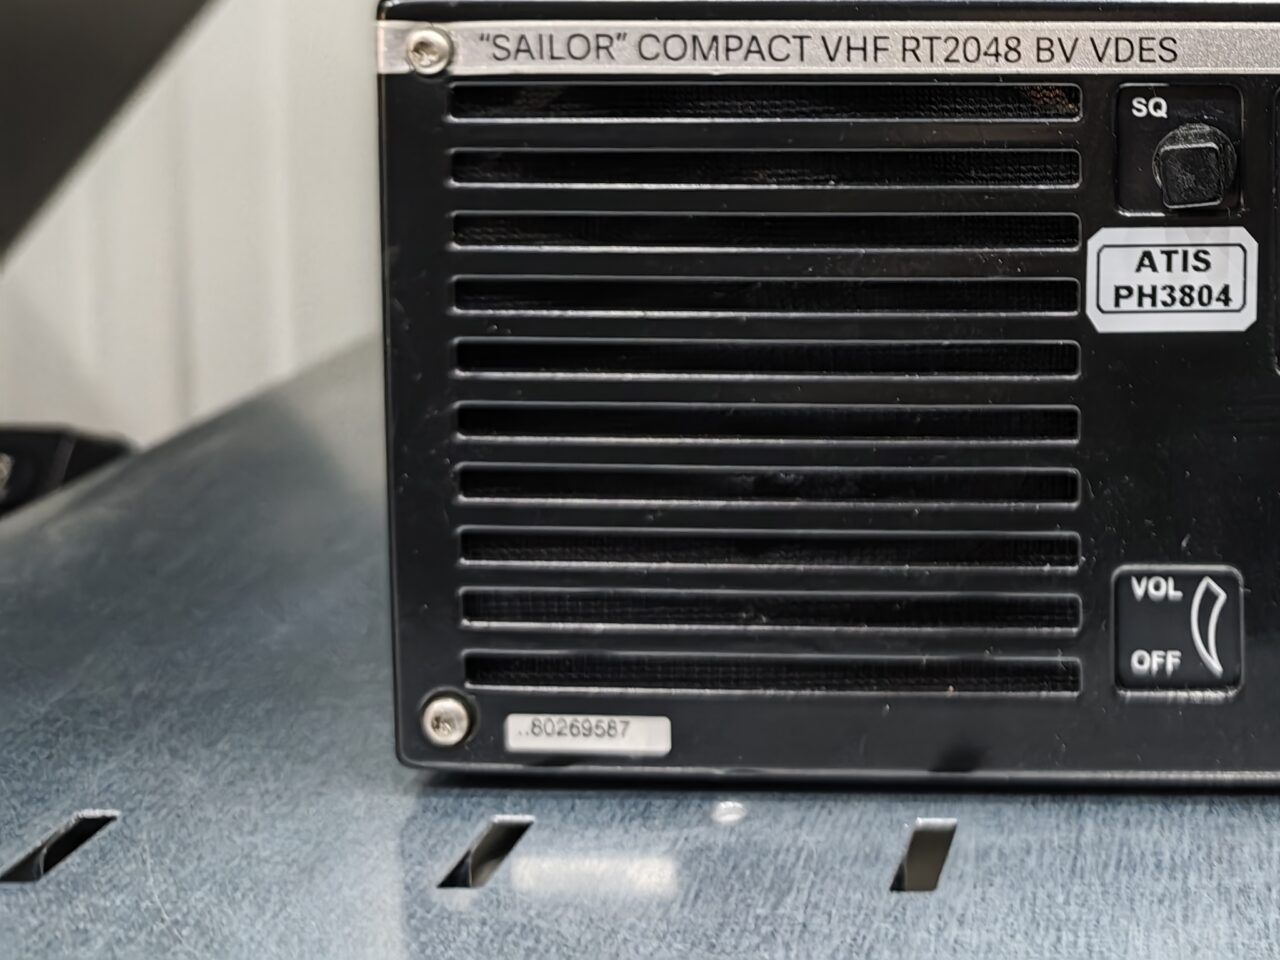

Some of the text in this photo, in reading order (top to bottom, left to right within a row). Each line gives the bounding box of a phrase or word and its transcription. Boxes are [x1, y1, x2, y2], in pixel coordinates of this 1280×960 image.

[637, 34, 811, 62] COMPACT
[820, 35, 890, 63] VHF
[901, 36, 1022, 63] RT2048
[1036, 37, 1079, 63] BV
[1089, 37, 1179, 63] VDES
[1131, 96, 1169, 119] SQ
[1135, 249, 1212, 273] ATIS
[1113, 284, 1233, 308] PH3804
[1130, 576, 1184, 602] VOL
[1130, 649, 1183, 678] OFF
